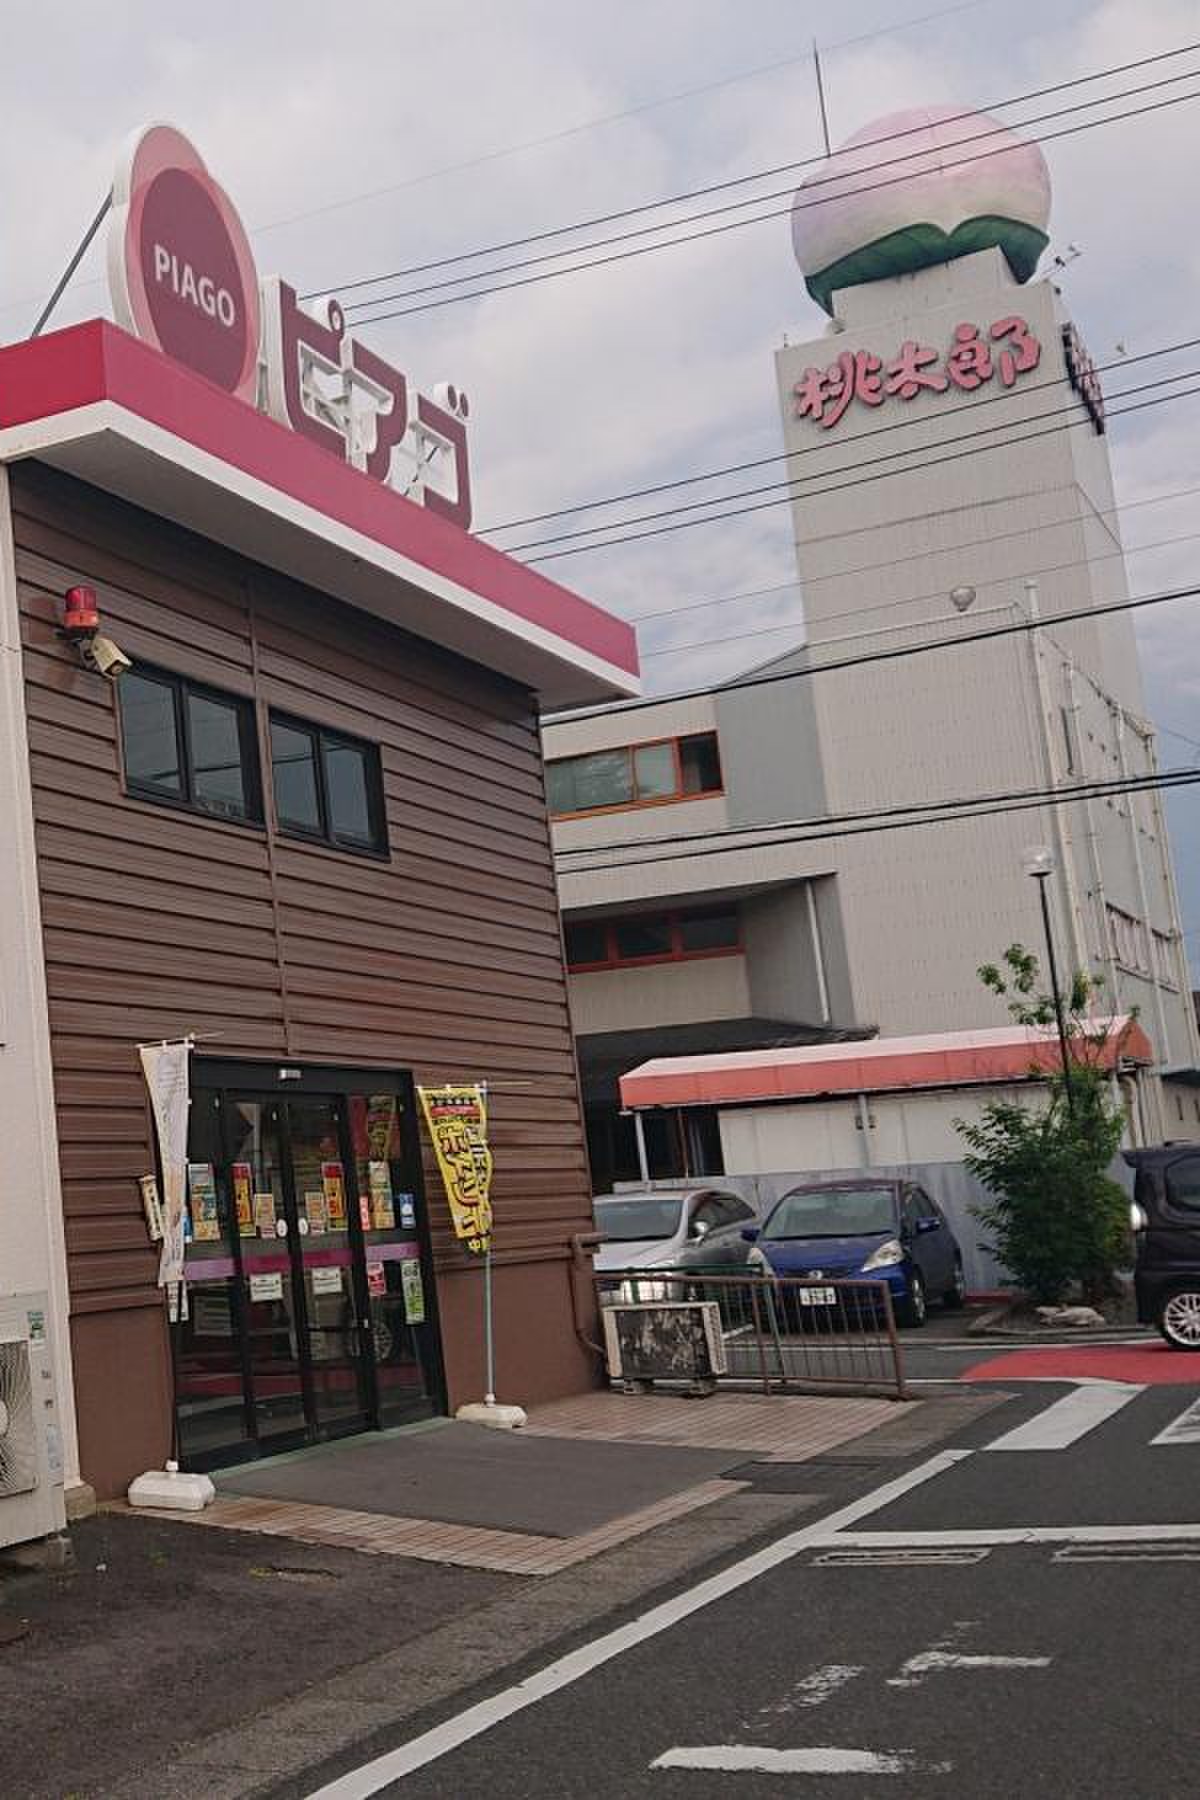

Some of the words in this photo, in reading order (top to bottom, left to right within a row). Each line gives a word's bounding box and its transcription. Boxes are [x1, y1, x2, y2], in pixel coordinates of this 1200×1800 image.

[153, 243, 236, 328] PIAGO
[278, 279, 473, 530] ピアゴ
[795, 316, 1041, 430] 桃太郎
